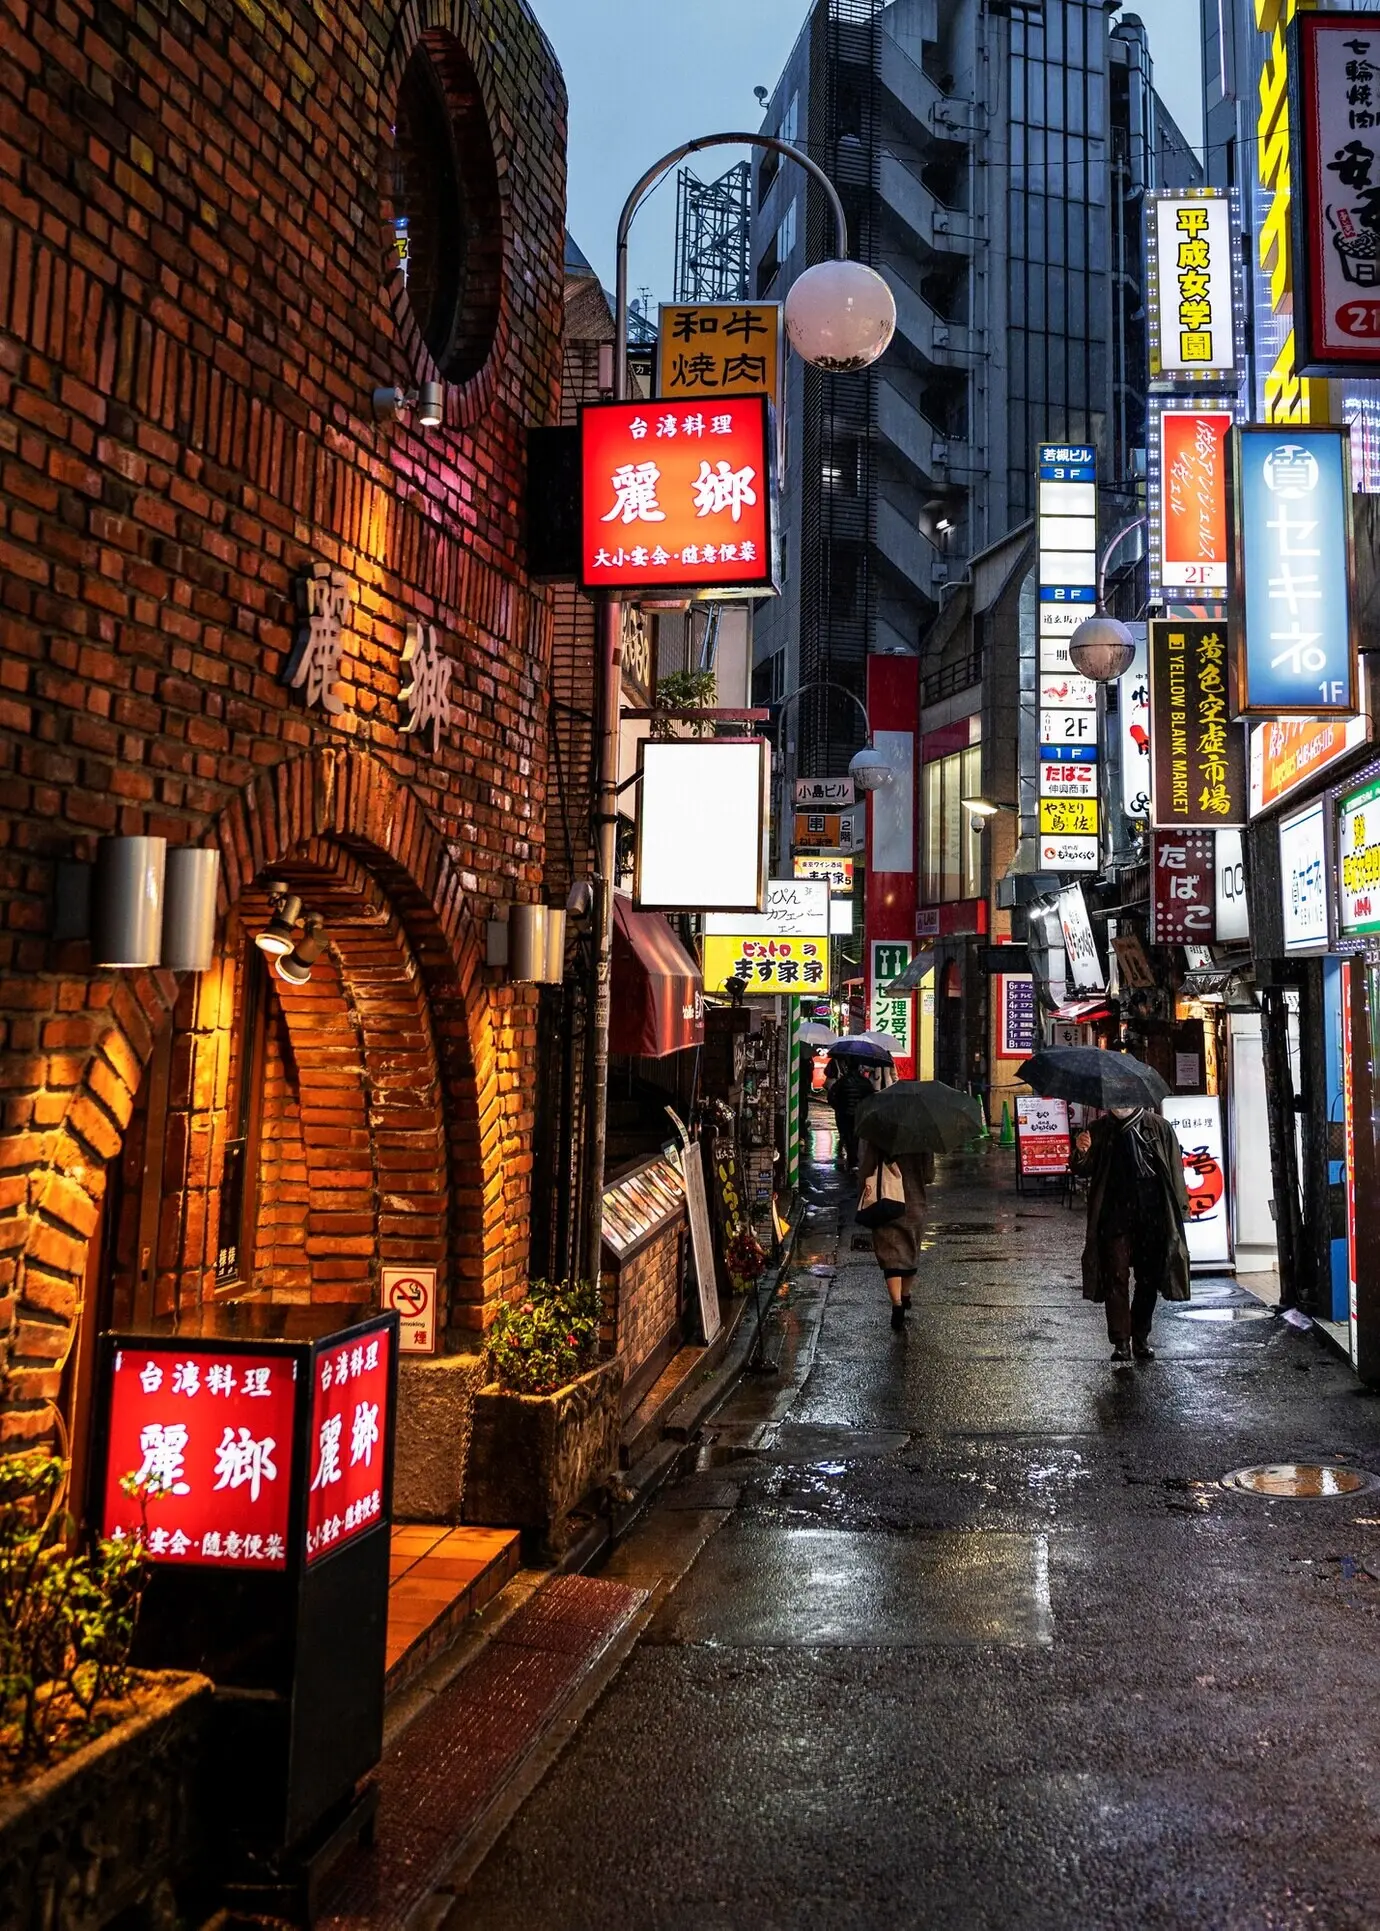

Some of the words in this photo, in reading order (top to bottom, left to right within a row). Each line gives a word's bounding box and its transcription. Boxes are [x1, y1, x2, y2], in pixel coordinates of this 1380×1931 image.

[1176, 208, 1213, 362] 平成女学園
[672, 310, 768, 344] 和牛
[670, 353, 767, 387] 焼肉
[629, 413, 733, 440] 台湾料理
[1054, 468, 1080, 479] 3F
[1266, 447, 1316, 498] 質
[600, 460, 757, 524] 麗郷
[1185, 566, 1213, 583] 2F
[1054, 588, 1081, 599] 2F
[1266, 504, 1326, 673] セキネ
[1169, 655, 1185, 708] YELLOW
[1318, 680, 1343, 702] 1F
[1065, 717, 1088, 737] 2F
[1171, 713, 1186, 755] BLANK
[1196, 632, 1230, 815] 黄色空虚市場
[1055, 748, 1082, 759] 1F
[1046, 766, 1092, 781] たばこ
[799, 784, 849, 798] 小島ビル
[1172, 760, 1188, 815] MARKET
[1044, 802, 1084, 815] やきとり
[809, 816, 824, 832] 串
[841, 821, 851, 842] 2階
[1158, 844, 1211, 930] たばこ
[742, 940, 791, 958] ビストロ
[734, 958, 799, 983] ます家
[414, 1330, 427, 1345] 煙
[139, 1361, 272, 1397] 台湾料理
[320, 1340, 379, 1393] 台湾料理
